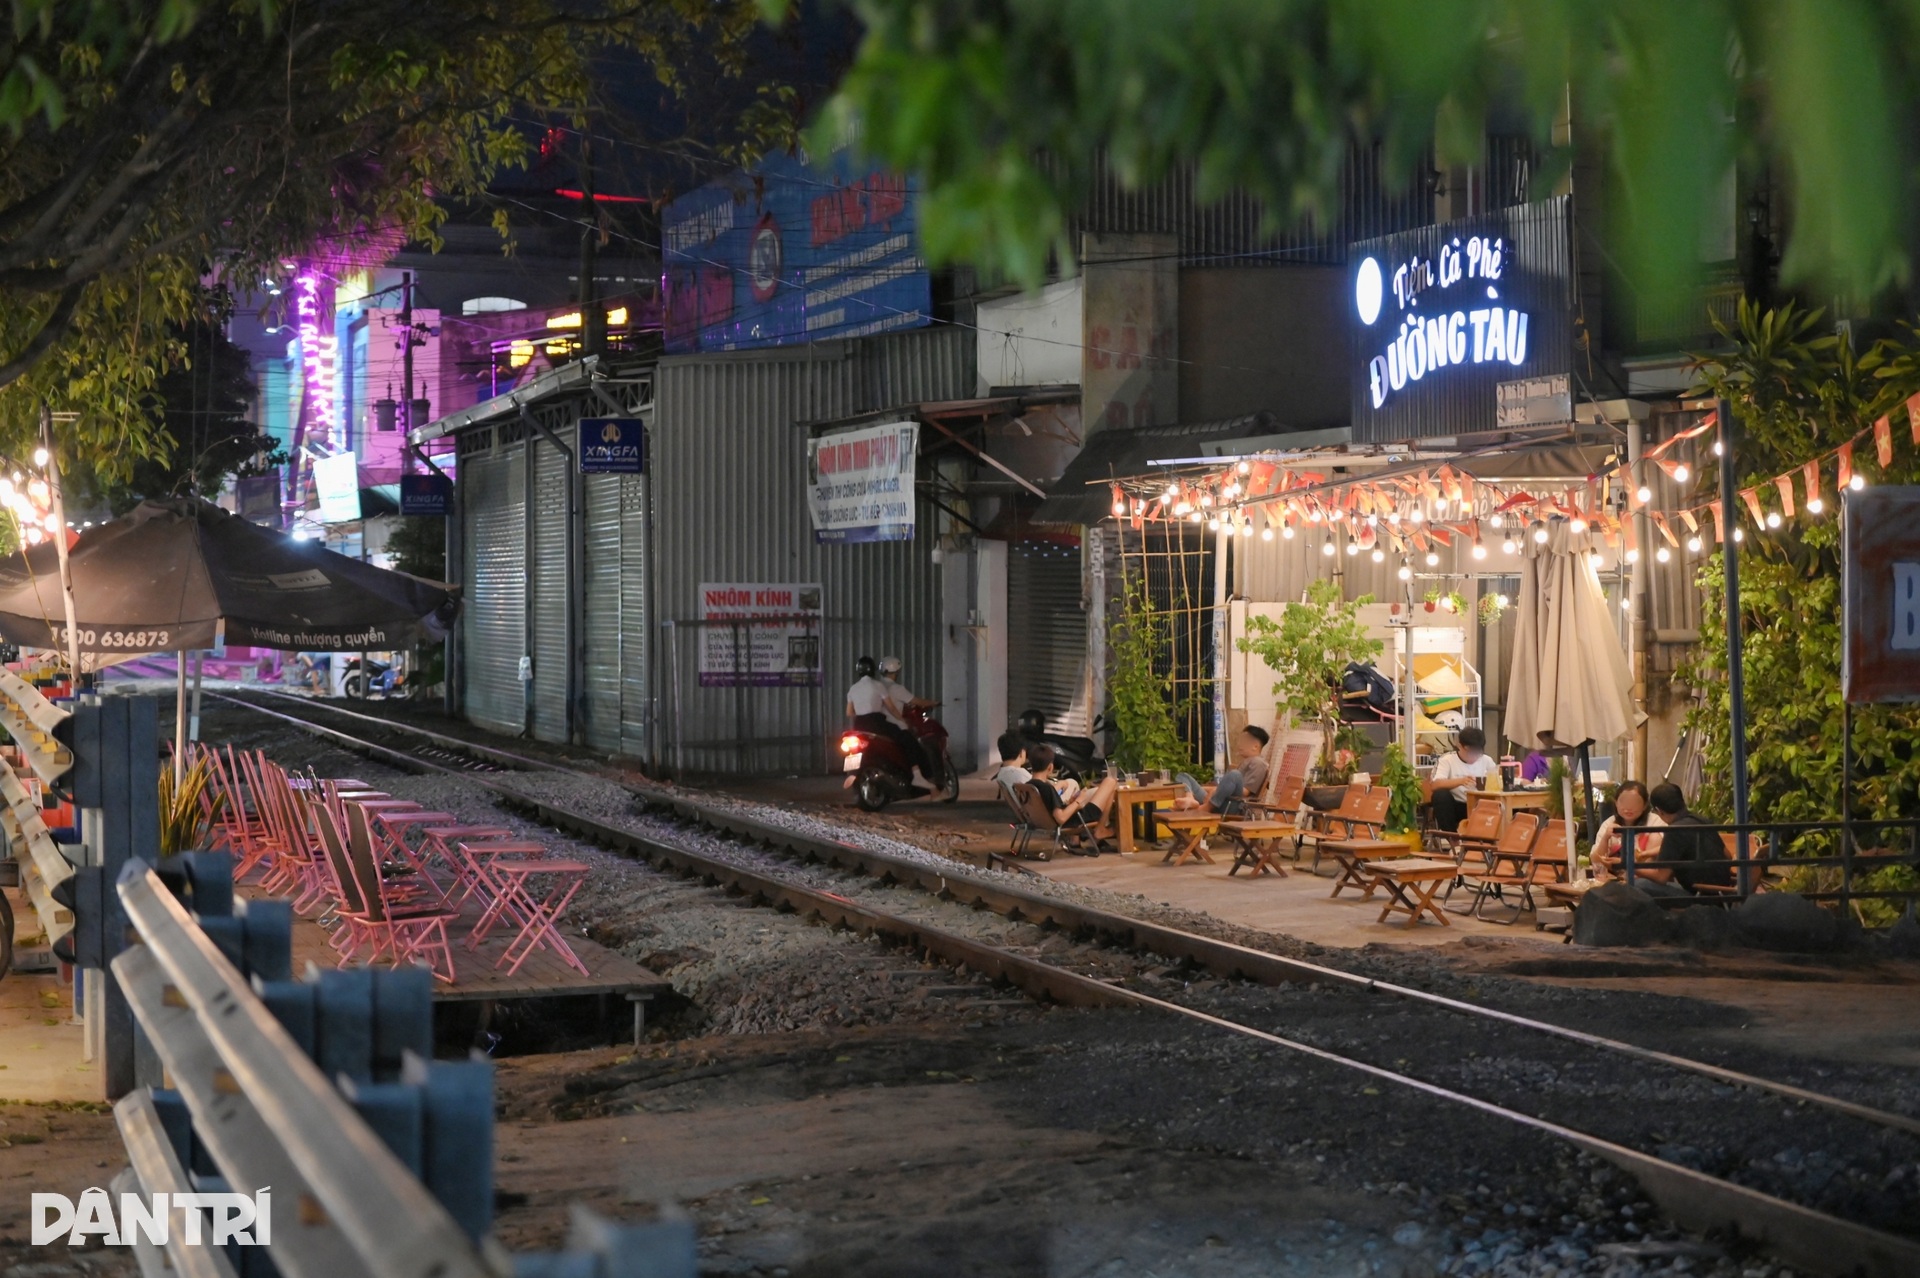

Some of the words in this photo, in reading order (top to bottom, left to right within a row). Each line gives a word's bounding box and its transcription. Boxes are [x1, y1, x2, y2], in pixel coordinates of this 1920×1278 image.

[1393, 255, 1434, 310] Tiệm
[1439, 237, 1462, 288] Cà
[1467, 236, 1502, 280] Phê
[1369, 311, 1466, 409] ĐƯỜNG
[1470, 285, 1528, 366] TÀU
[585, 446, 638, 457] XINGFA
[705, 587, 751, 607] NHÔM
[756, 587, 792, 607] KÍNH
[51, 626, 96, 645] 1900
[101, 631, 169, 647] 636873
[250, 627, 291, 645] Hotline
[294, 630, 341, 649] nhượng
[345, 626, 386, 650] quyền
